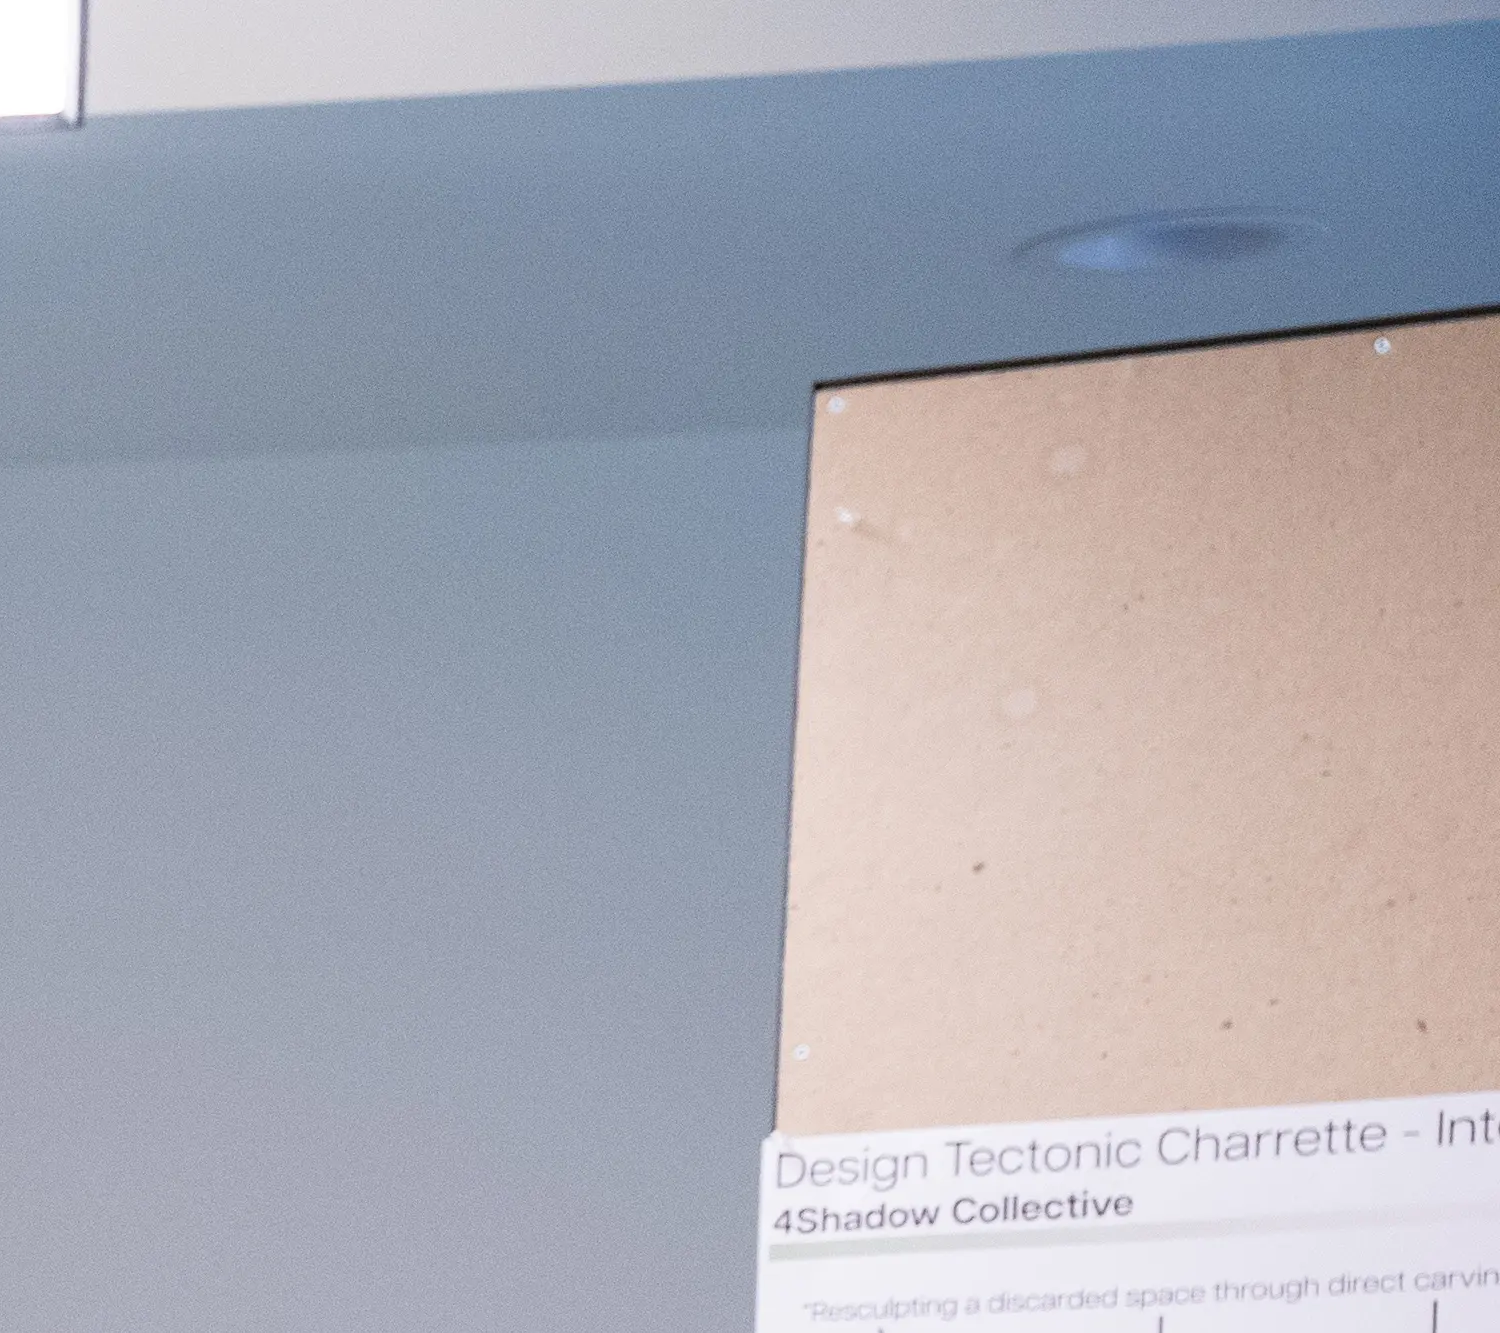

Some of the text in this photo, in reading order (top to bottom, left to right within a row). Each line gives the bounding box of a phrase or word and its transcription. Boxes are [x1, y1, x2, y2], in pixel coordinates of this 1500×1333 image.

[776, 1149, 929, 1192] Design
[945, 1130, 1143, 1179] Tectonic
[1157, 1118, 1389, 1167] Charrette
[1437, 1108, 1500, 1147] Int
[773, 1191, 1134, 1236] 4Shadow Collective
[965, 1299, 980, 1315] a
[987, 1287, 1118, 1314] discarded
[1126, 1285, 1205, 1310] space
[1214, 1274, 1320, 1303] through
[1328, 1269, 1405, 1294] direct
